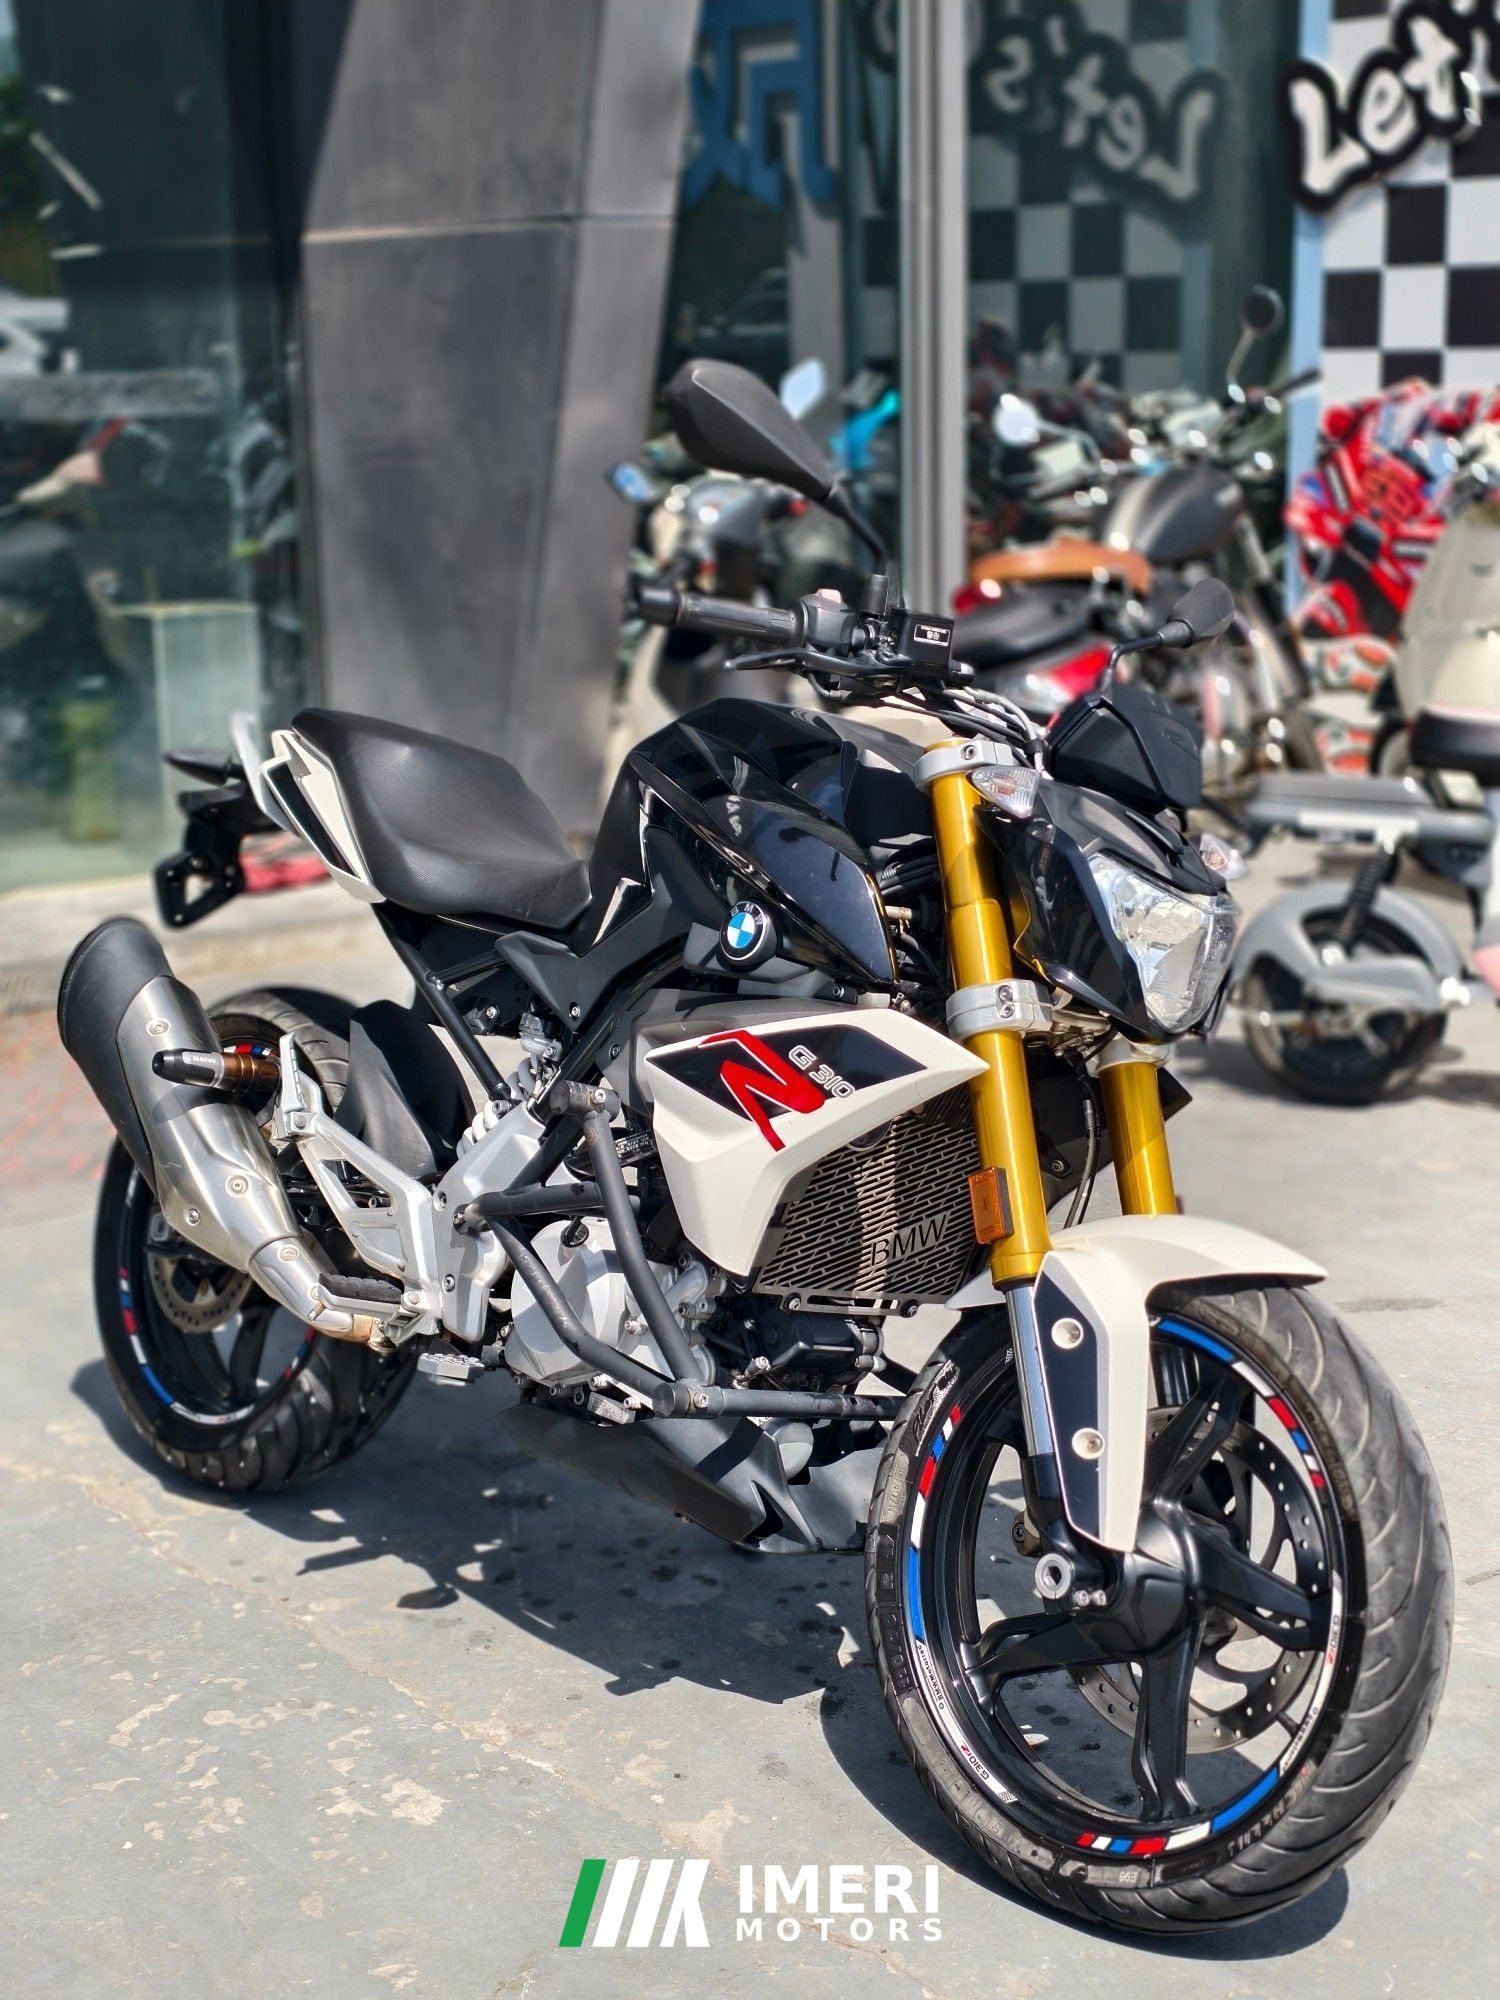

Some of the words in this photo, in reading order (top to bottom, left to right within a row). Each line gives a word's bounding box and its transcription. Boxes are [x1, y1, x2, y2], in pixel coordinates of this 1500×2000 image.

[1288, 0, 1500, 197] Let
[730, 903, 763, 925] BMW
[788, 1045, 817, 1071] G
[809, 1064, 856, 1099] 310
[870, 1214, 947, 1267] BMW
